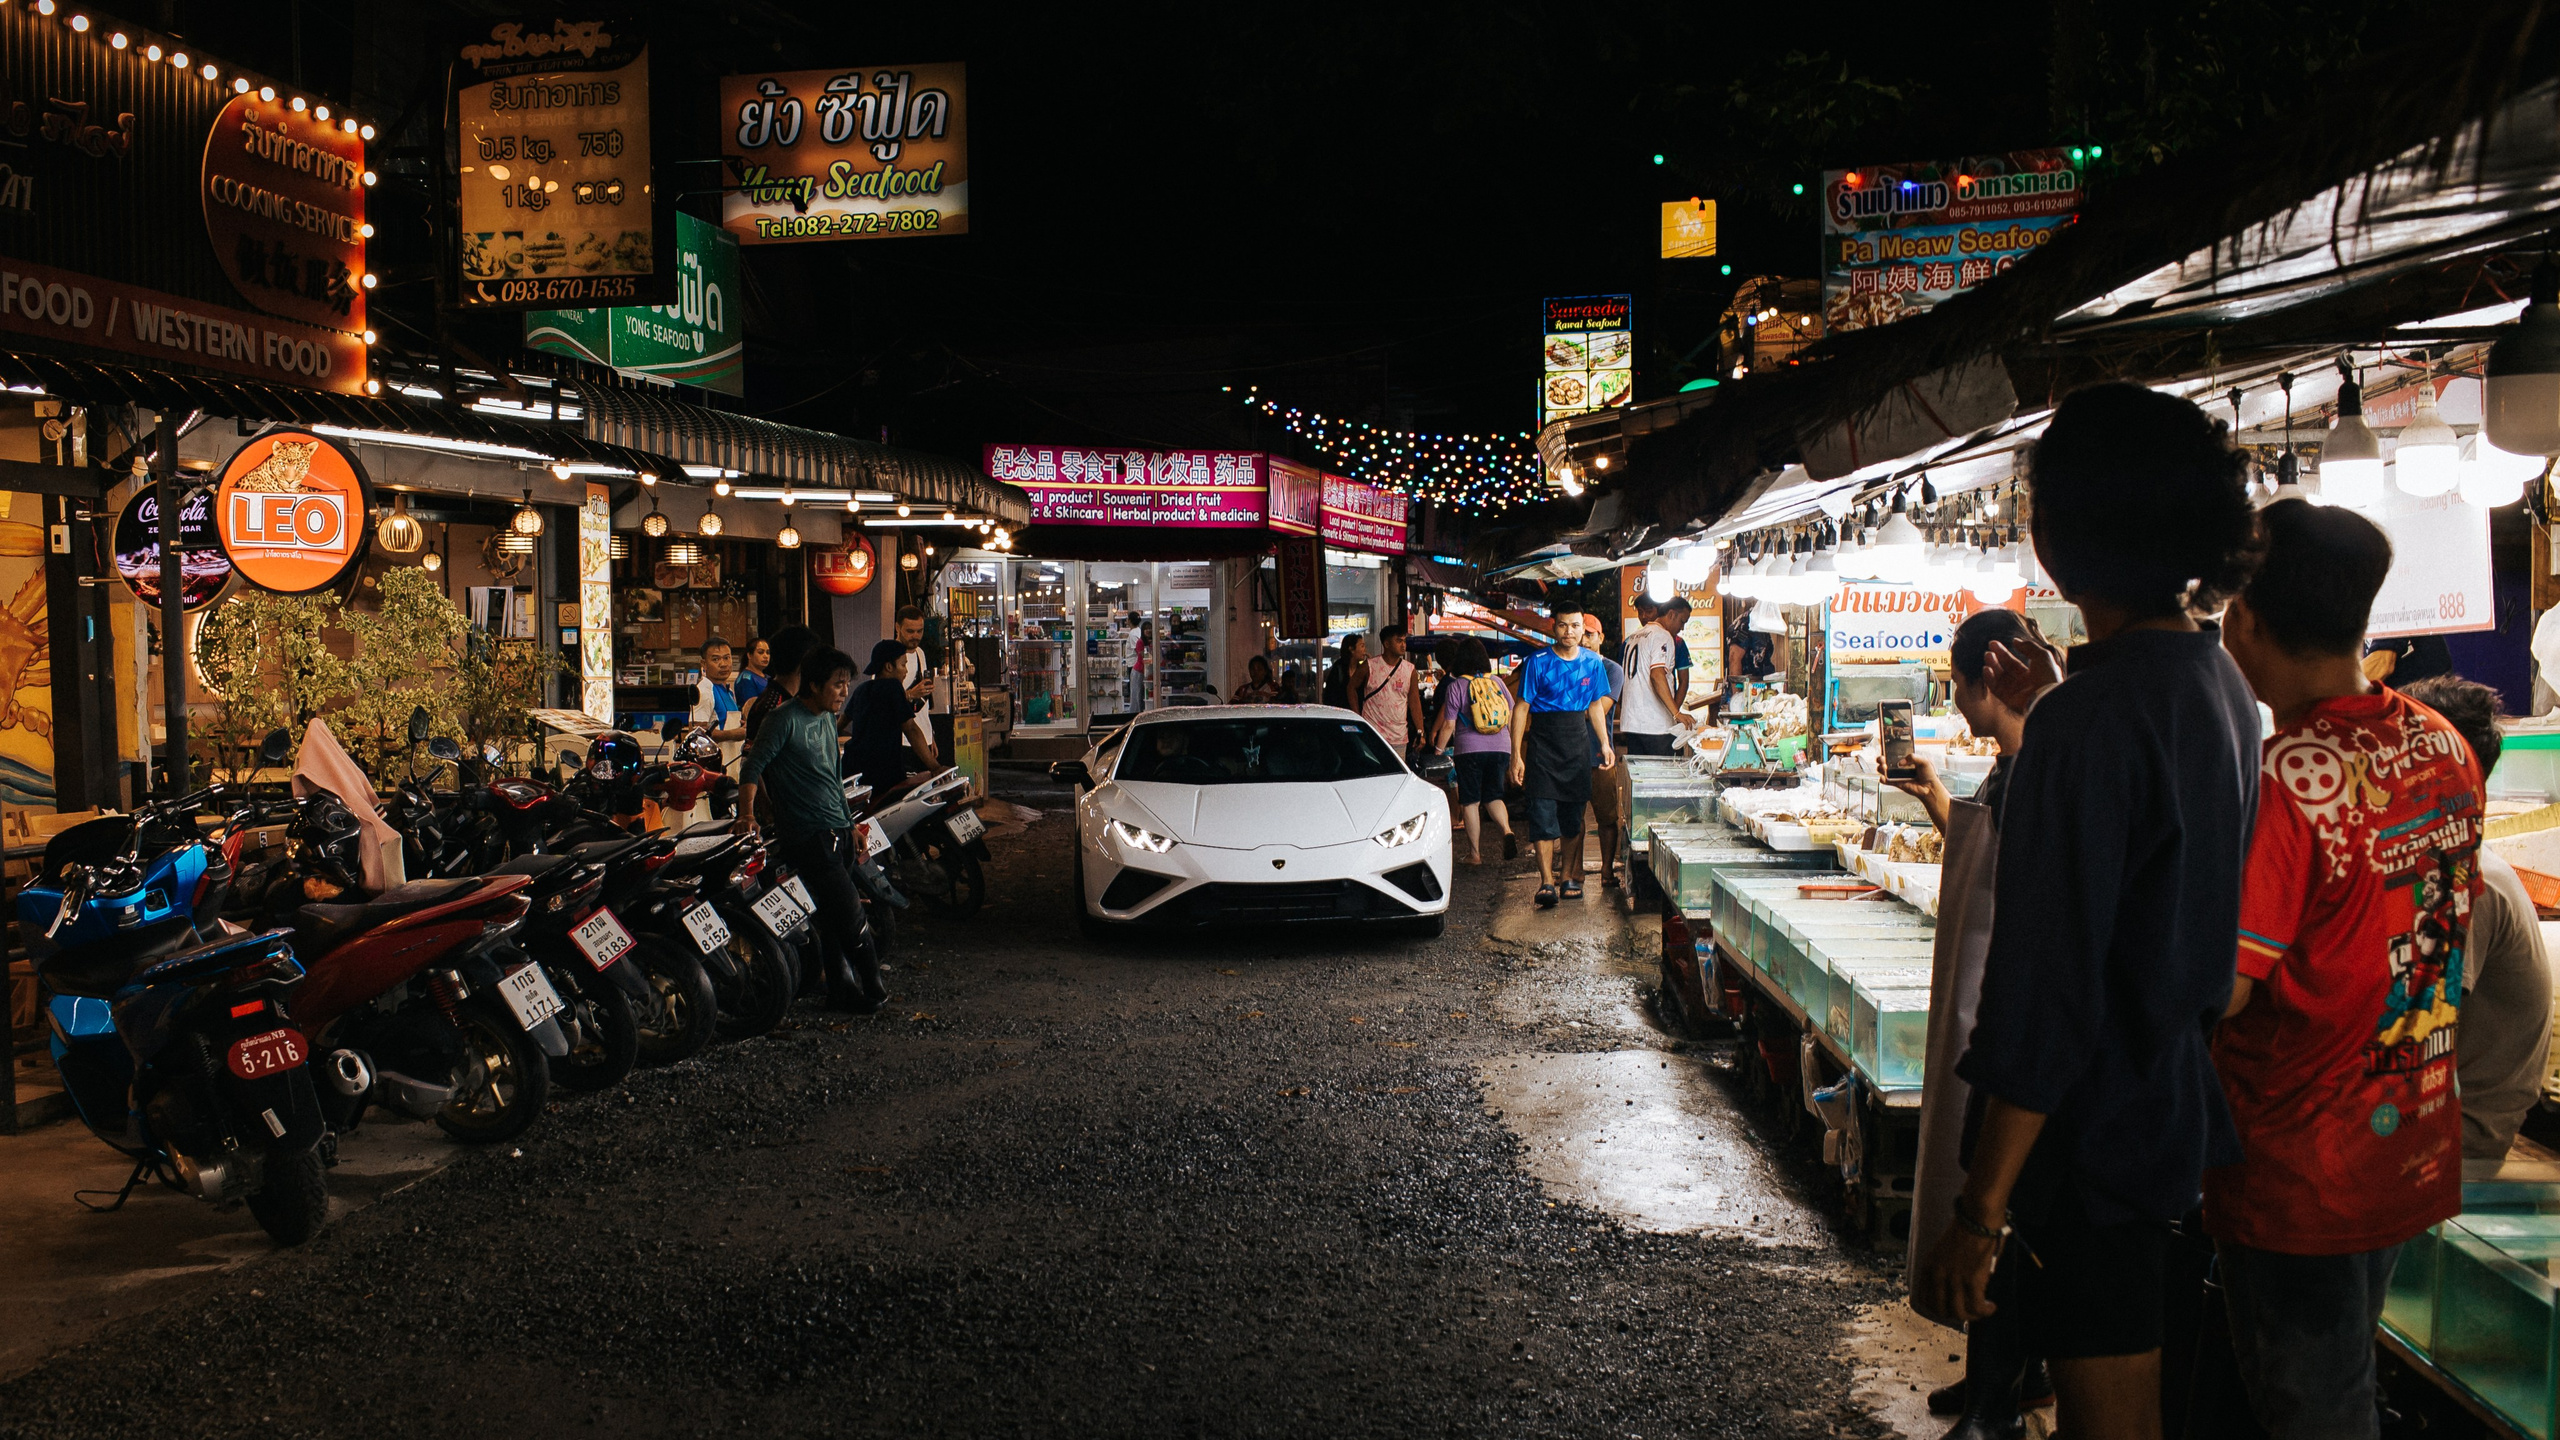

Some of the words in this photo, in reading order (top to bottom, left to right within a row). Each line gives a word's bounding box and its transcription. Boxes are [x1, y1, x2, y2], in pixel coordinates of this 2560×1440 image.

[489, 78, 620, 110] รับทำอาหาร
[739, 78, 803, 148] ย้ง
[817, 71, 950, 162] ซีฟู้ด
[241, 107, 358, 190] รับทำอาหาร
[480, 137, 516, 160] 0.5
[522, 135, 556, 163] kg.
[742, 166, 814, 205] Yong
[823, 158, 944, 200] Seafood
[210, 174, 292, 224] COOKING
[295, 200, 360, 246] SERVICE
[503, 185, 513, 208] 1
[518, 184, 551, 212] kg.
[757, 209, 939, 240] Tel:082-272-7802
[1841, 238, 1874, 262] Pa
[1879, 234, 1953, 260] Meaw
[1959, 224, 2062, 253] Seafoo
[501, 276, 637, 302] 093-670-1535
[1547, 298, 1629, 319] Sawasdee
[625, 315, 651, 338] YONG
[652, 324, 691, 351] SEAFOOD
[1555, 319, 1583, 331] Rawai
[1586, 316, 1622, 331] Seafood
[131, 299, 255, 365] WESTERN
[262, 330, 332, 379] FOOD
[992, 446, 1057, 482] 纪念品
[1061, 449, 1146, 484] 零食干货
[1149, 451, 1210, 485] 化妆品
[1214, 453, 1256, 486] 药品
[1048, 490, 1094, 508] product
[1102, 491, 1153, 507] Souvenir
[1161, 492, 1193, 507] Dried
[1196, 493, 1222, 507] fruit
[232, 495, 342, 547] LEO
[1055, 505, 1105, 520] Skincare
[1112, 507, 1151, 521] Herbal
[1152, 507, 1197, 525] product
[1199, 509, 1208, 520] &
[1210, 507, 1260, 522] medicine
[1288, 543, 1310, 635] MINIMART
[2439, 592, 2465, 620] 888
[1832, 630, 1929, 649] Seafood
[774, 909, 801, 933] 6823
[597, 936, 628, 963] 6183
[701, 927, 728, 951] 8152
[526, 996, 556, 1022] 1171
